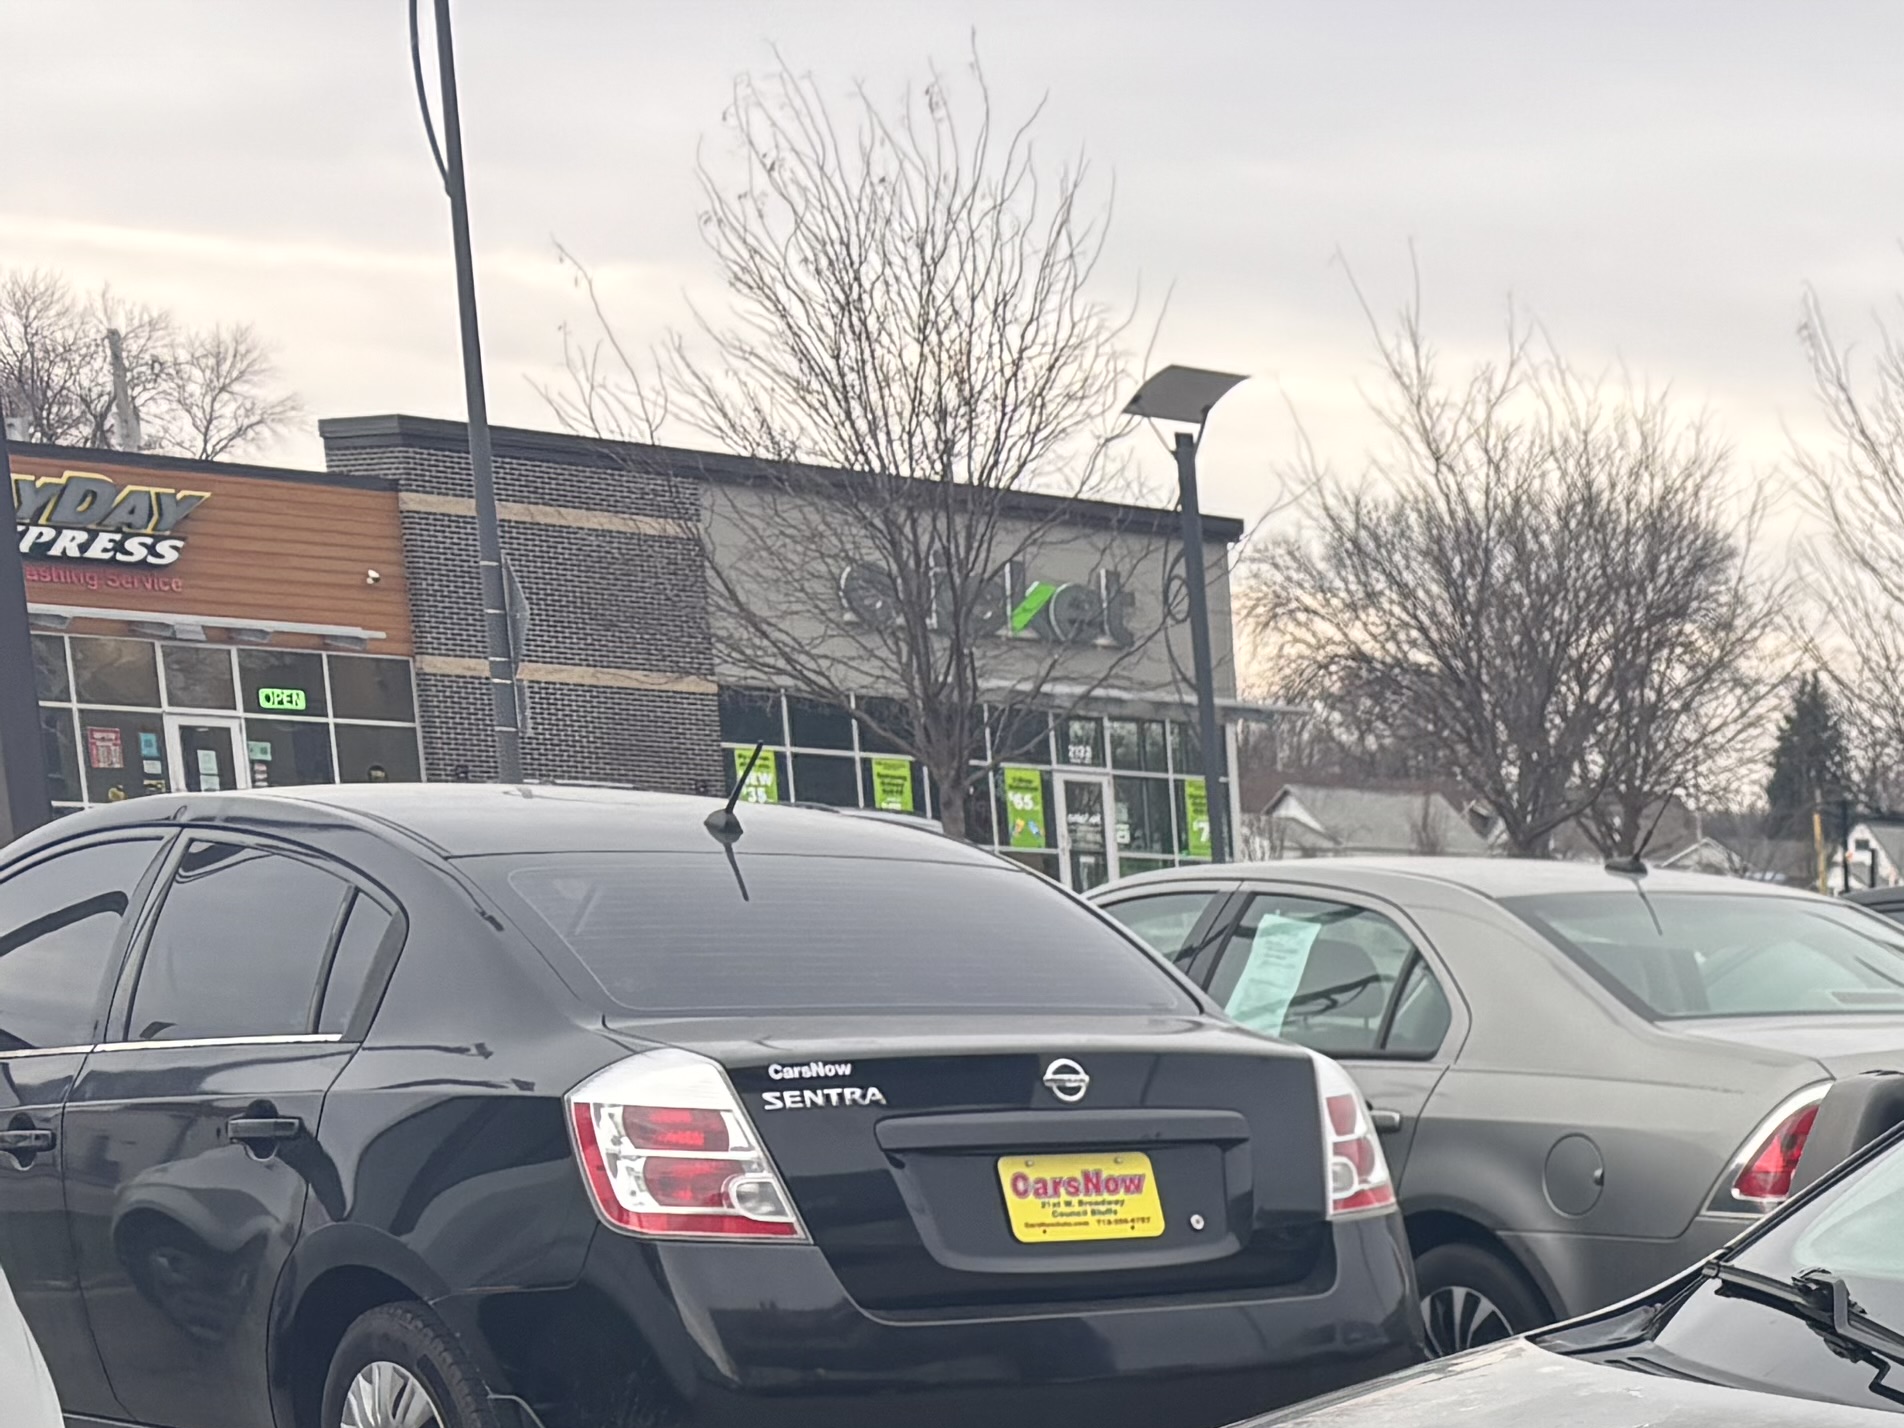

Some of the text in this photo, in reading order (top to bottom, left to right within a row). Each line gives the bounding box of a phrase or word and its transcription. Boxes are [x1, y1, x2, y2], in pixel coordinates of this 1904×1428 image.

[11, 471, 211, 534] YDAY
[17, 525, 185, 565] PRESS
[27, 566, 183, 593] ashing Service
[260, 688, 305, 709] OPEN
[768, 1062, 852, 1080] CarsNow
[762, 1087, 887, 1110] SENTRA
[1010, 1168, 1146, 1199] CarsNow
[1051, 1208, 1118, 1218] Council Bluffs
